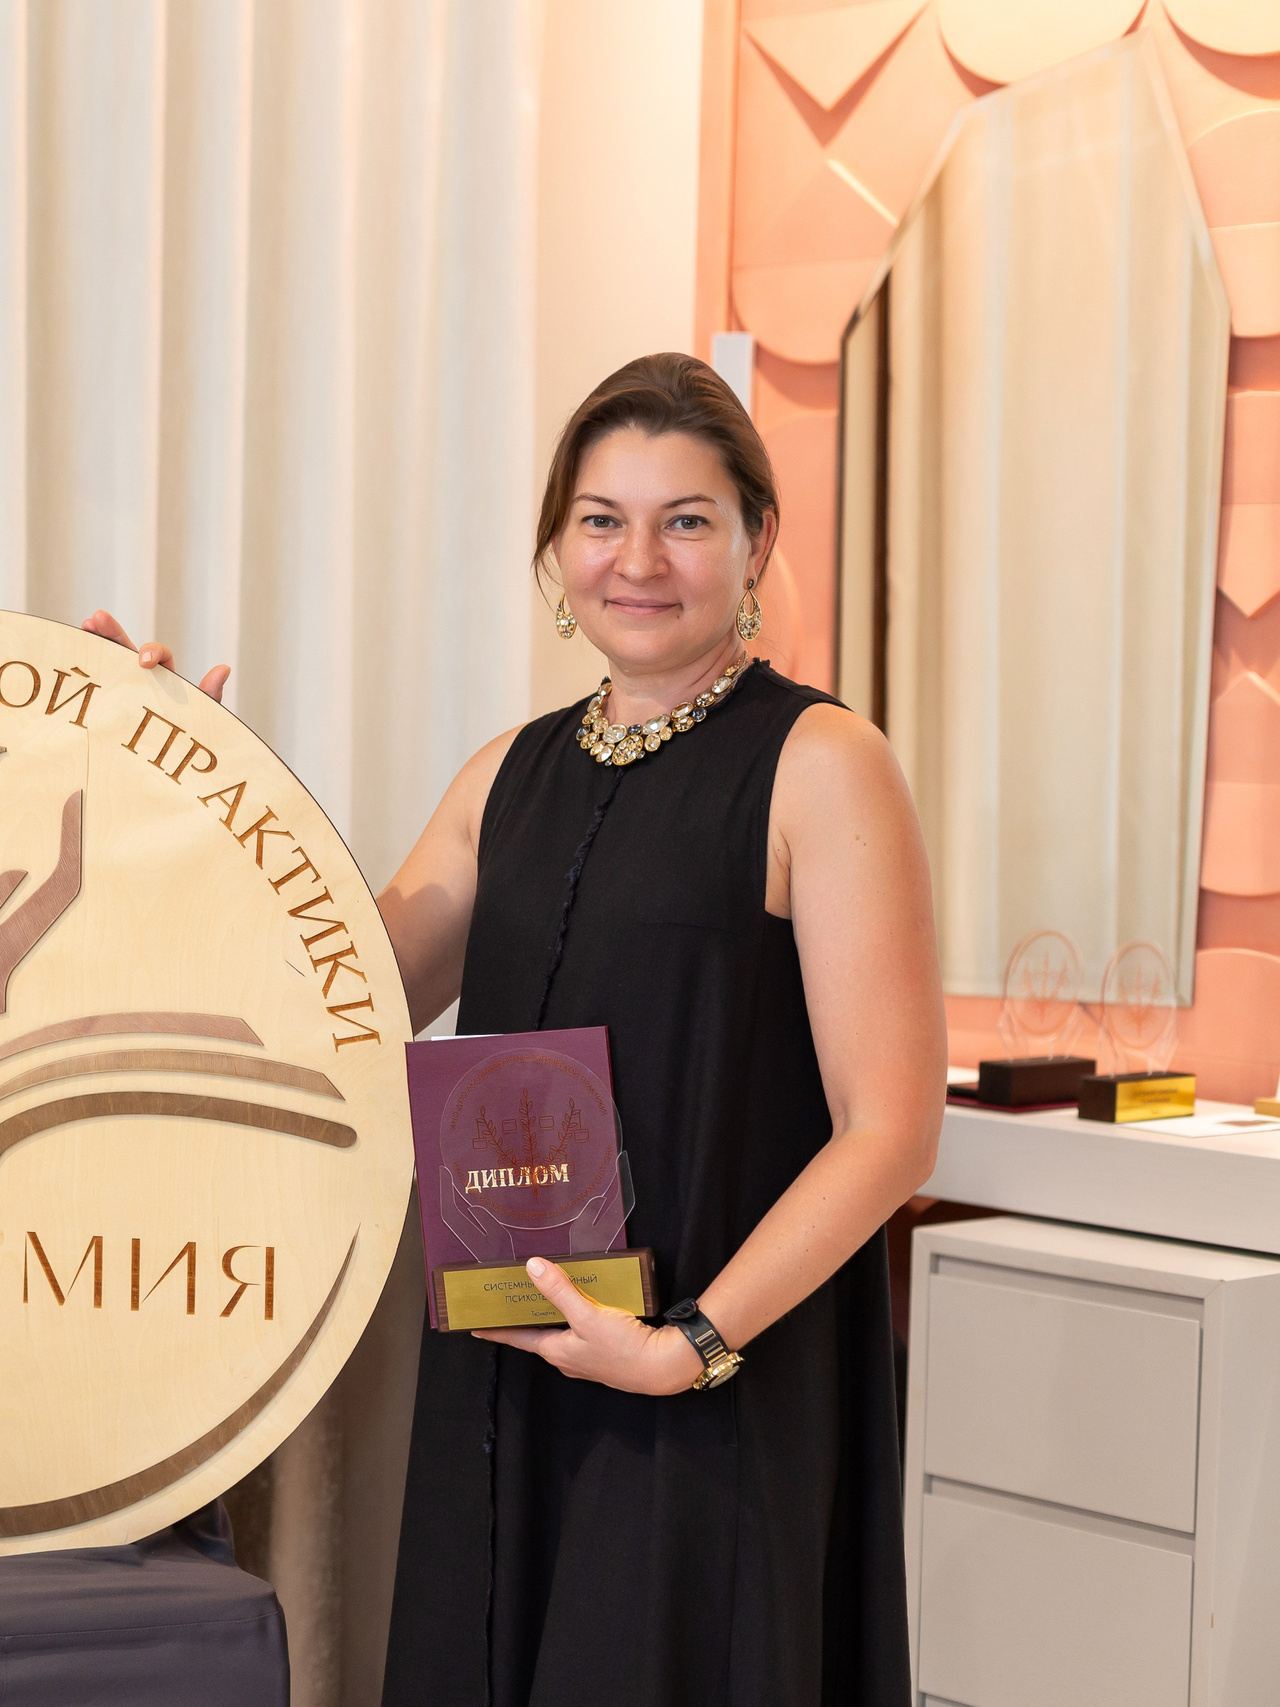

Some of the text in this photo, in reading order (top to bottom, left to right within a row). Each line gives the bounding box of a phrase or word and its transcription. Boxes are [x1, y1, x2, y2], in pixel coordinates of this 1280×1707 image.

[121, 706, 381, 1053] ПРАКТИКИ
[465, 1163, 570, 1194] ДИПЛОМ
[483, 1281, 536, 1292] СИСТЕМНЫ
[505, 1293, 548, 1303] ПСИХОТЕ
